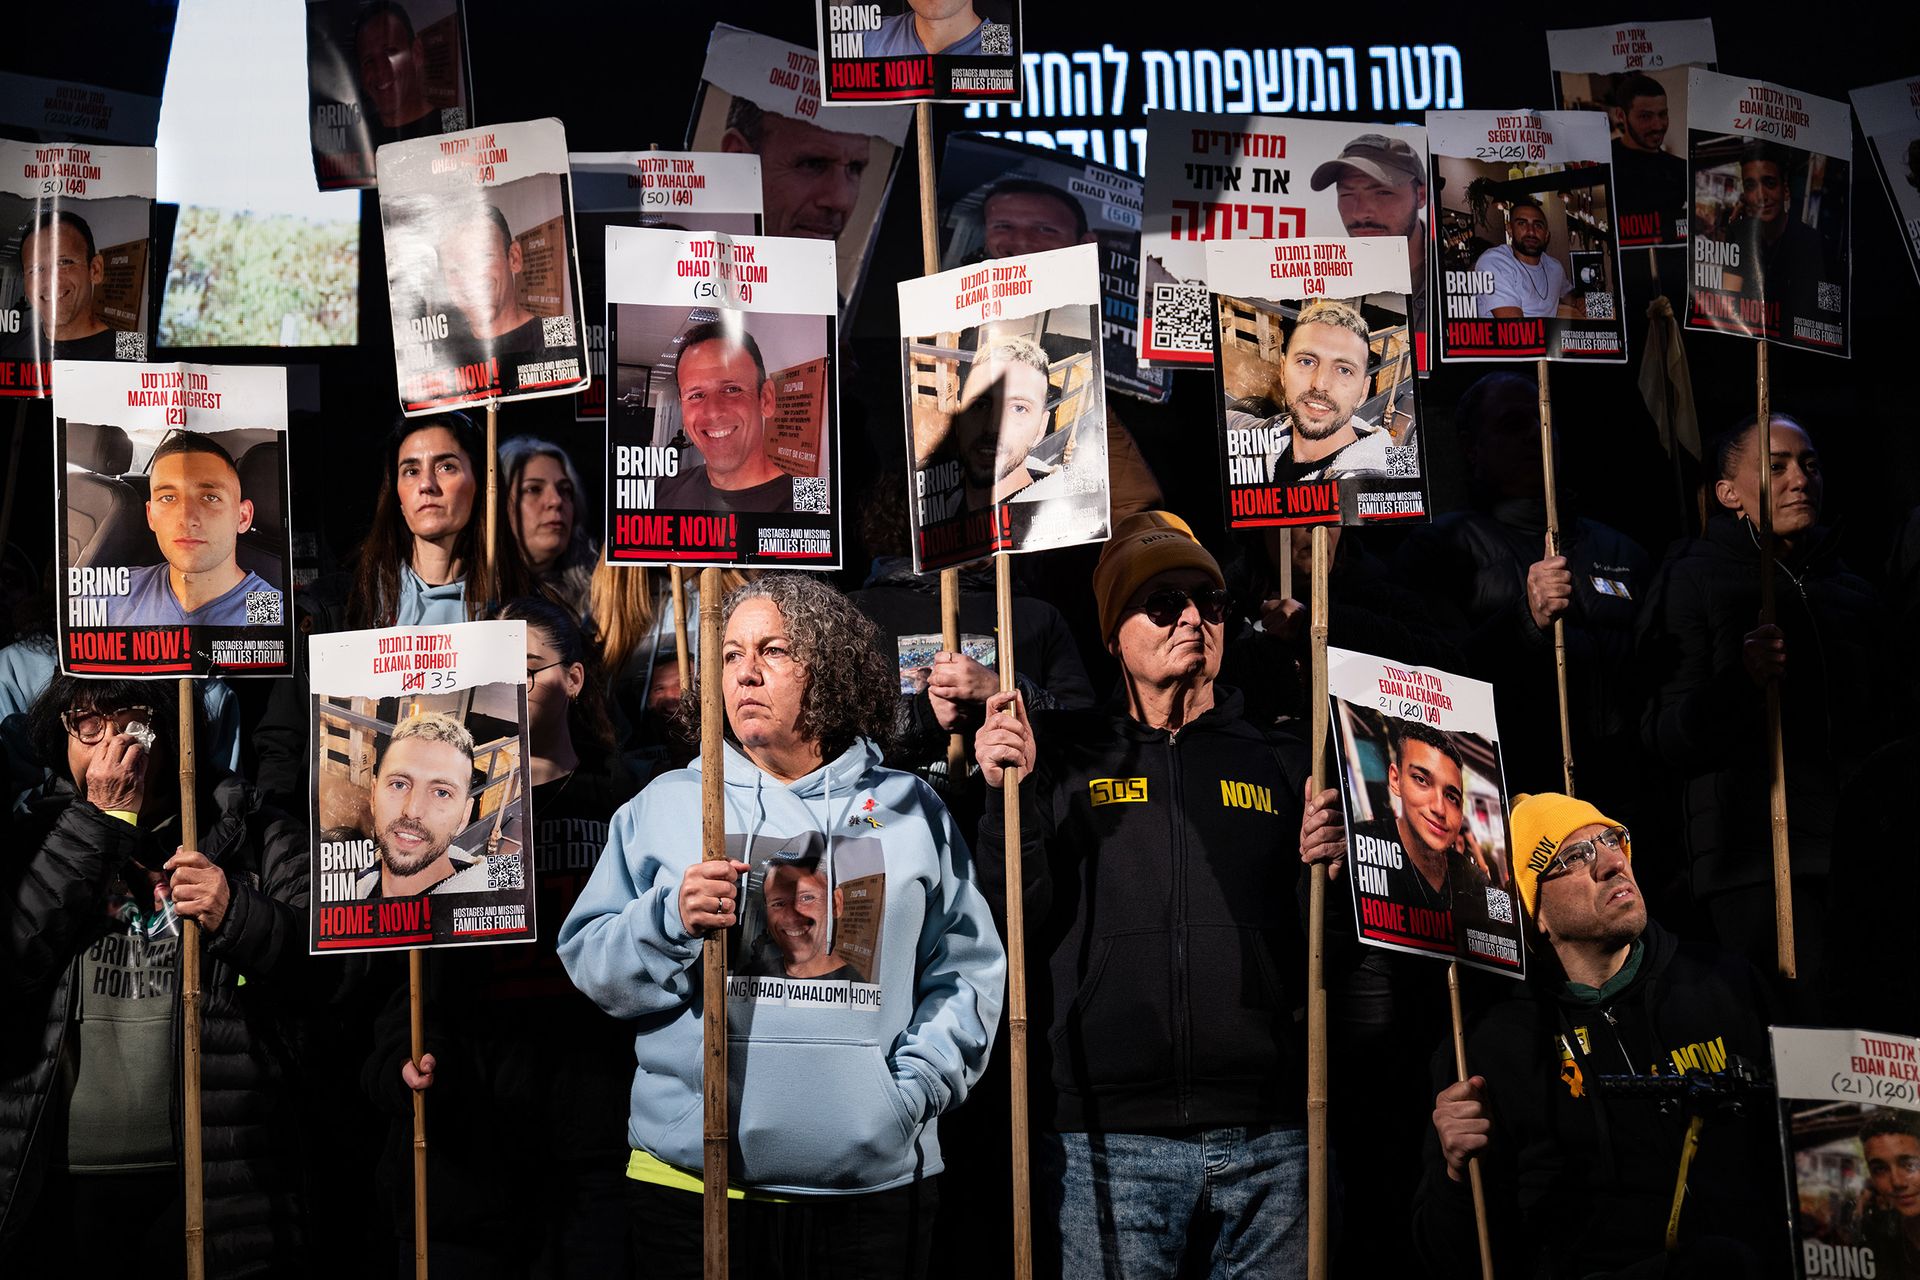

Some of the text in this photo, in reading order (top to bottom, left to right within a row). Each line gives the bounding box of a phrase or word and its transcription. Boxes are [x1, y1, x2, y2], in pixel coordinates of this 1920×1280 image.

[830, 4, 882, 31] BRING
[831, 33, 864, 58] HIM
[1612, 42, 1653, 56] ITAY CHEN
[769, 67, 800, 91] OHAD
[832, 61, 881, 88] HOME
[885, 56, 934, 87] NOW!
[951, 68, 1014, 78] HOSTAGES MISSING
[1142, 45, 1464, 113] מטה המשפחות
[951, 77, 1014, 91] FAMILIES FORUM
[795, 95, 819, 120] (49)
[1748, 87, 1785, 106] אלכסנדר
[317, 103, 361, 125] BRING
[1497, 116, 1542, 129] שגב כלפון
[1740, 101, 1810, 128] EDAN ALEXANDER
[1191, 129, 1287, 159] מחזירים
[1488, 130, 1553, 144] SEGEV KALFON
[67, 148, 91, 164] אוהד
[637, 158, 694, 173] אוהד יהלומי
[24, 164, 50, 178] OHAD
[628, 175, 705, 189] OHAD YAHALOMI
[1090, 168, 1133, 191] יהלומי
[1183, 163, 1291, 194] את איתי
[640, 191, 670, 206] (50)
[672, 190, 693, 206] (49)
[1071, 180, 1106, 199] OHAD
[1275, 244, 1347, 261] אלקנה בוחבוט
[1695, 235, 1740, 267] BRING
[678, 260, 710, 277] OHAD
[961, 265, 1027, 292] אלקנה בוחבוט
[1270, 262, 1353, 278] ELKANA BOHBOT
[1695, 262, 1723, 290] HIM
[1303, 278, 1325, 295] (34)
[1445, 270, 1494, 294] BRING
[955, 280, 1033, 310] ELKANA BOHBOT
[1694, 290, 1736, 319] HOME
[981, 299, 1002, 320] (34)
[1447, 296, 1478, 318] HIM
[1449, 319, 1545, 346] HOME NOW!
[1561, 338, 1619, 350] FAMILIES FORUM
[1793, 324, 1843, 345] FAMILIES FORUM
[141, 372, 208, 390] מתן אנגרסט
[454, 357, 500, 392] NOW!
[518, 366, 580, 385] FAMILIES FORUM
[128, 391, 222, 409] MATAN ANGREST
[166, 407, 187, 426] (21)
[1227, 428, 1282, 456] BRING
[616, 446, 679, 478] BRING
[1229, 457, 1264, 485] HIM
[916, 459, 960, 498] BRING
[616, 479, 655, 510] HIM
[1231, 480, 1339, 517] HOME NOW!
[1357, 491, 1421, 502] HOSTAGES AND MISSING
[917, 493, 948, 527] HIM
[1358, 500, 1424, 515] FAMILIES FORUM
[616, 514, 737, 548] HOME NOW!
[758, 528, 831, 540] HOSTAGES AND MISSING
[758, 539, 831, 554] FAMILIES FORUM
[68, 567, 130, 596] BRING
[68, 598, 108, 627] HIM
[70, 627, 191, 661] HOME NOW!
[212, 641, 284, 650] HOSTAGES AND MISSING
[379, 634, 452, 655] אלקנה בוחבוט
[212, 650, 284, 664] FAMILIES FORUM
[374, 652, 459, 674] ELKANA BOHBOT
[402, 672, 426, 692] (34)
[431, 671, 457, 689] 35
[1424, 673, 1443, 692] עידן
[1378, 679, 1453, 711] EDAN ALEXANDER
[1379, 696, 1423, 721] 21 (20)
[1424, 705, 1441, 726] (19)
[1092, 780, 1144, 803] SOS
[1221, 779, 1279, 815] NOW.
[320, 838, 375, 871] BRING
[1355, 834, 1403, 870] BRING
[1528, 835, 1559, 874] NOW.
[320, 871, 357, 903] HIM
[1357, 864, 1389, 897] HIM
[319, 897, 432, 937] HOME NOW!
[453, 904, 525, 918] HOSTAGES AND MISSING
[1361, 896, 1406, 933] HOME
[453, 914, 526, 932] FAMILIES FORUM
[1467, 938, 1518, 962] FAMILIES FORUM
[751, 982, 882, 1006] OHAD YAHALOMI HOME
[1861, 1038, 1917, 1063] אלכסנדר
[1851, 1056, 1885, 1076] EDAN
[1802, 1239, 1877, 1280] BRING
